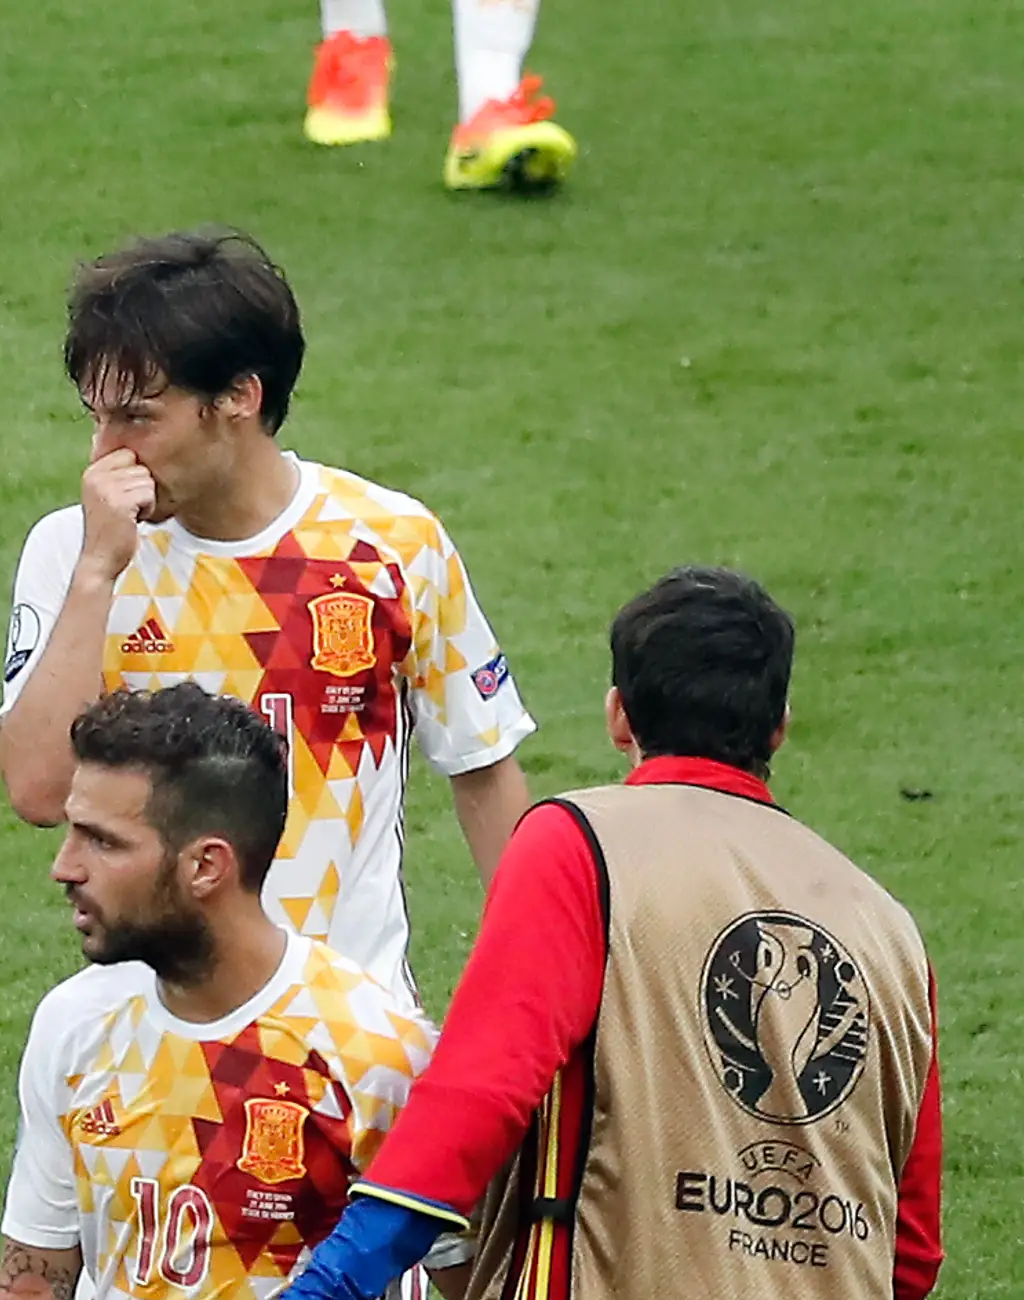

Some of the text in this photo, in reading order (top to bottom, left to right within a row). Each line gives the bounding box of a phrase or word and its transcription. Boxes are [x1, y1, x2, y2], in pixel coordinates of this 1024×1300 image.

[121, 639, 175, 654] adidas
[741, 1146, 815, 1184] UEFA
[675, 1172, 869, 1240] EURO2016
[130, 1176, 214, 1289] 10
[729, 1230, 829, 1267] FRANCE
